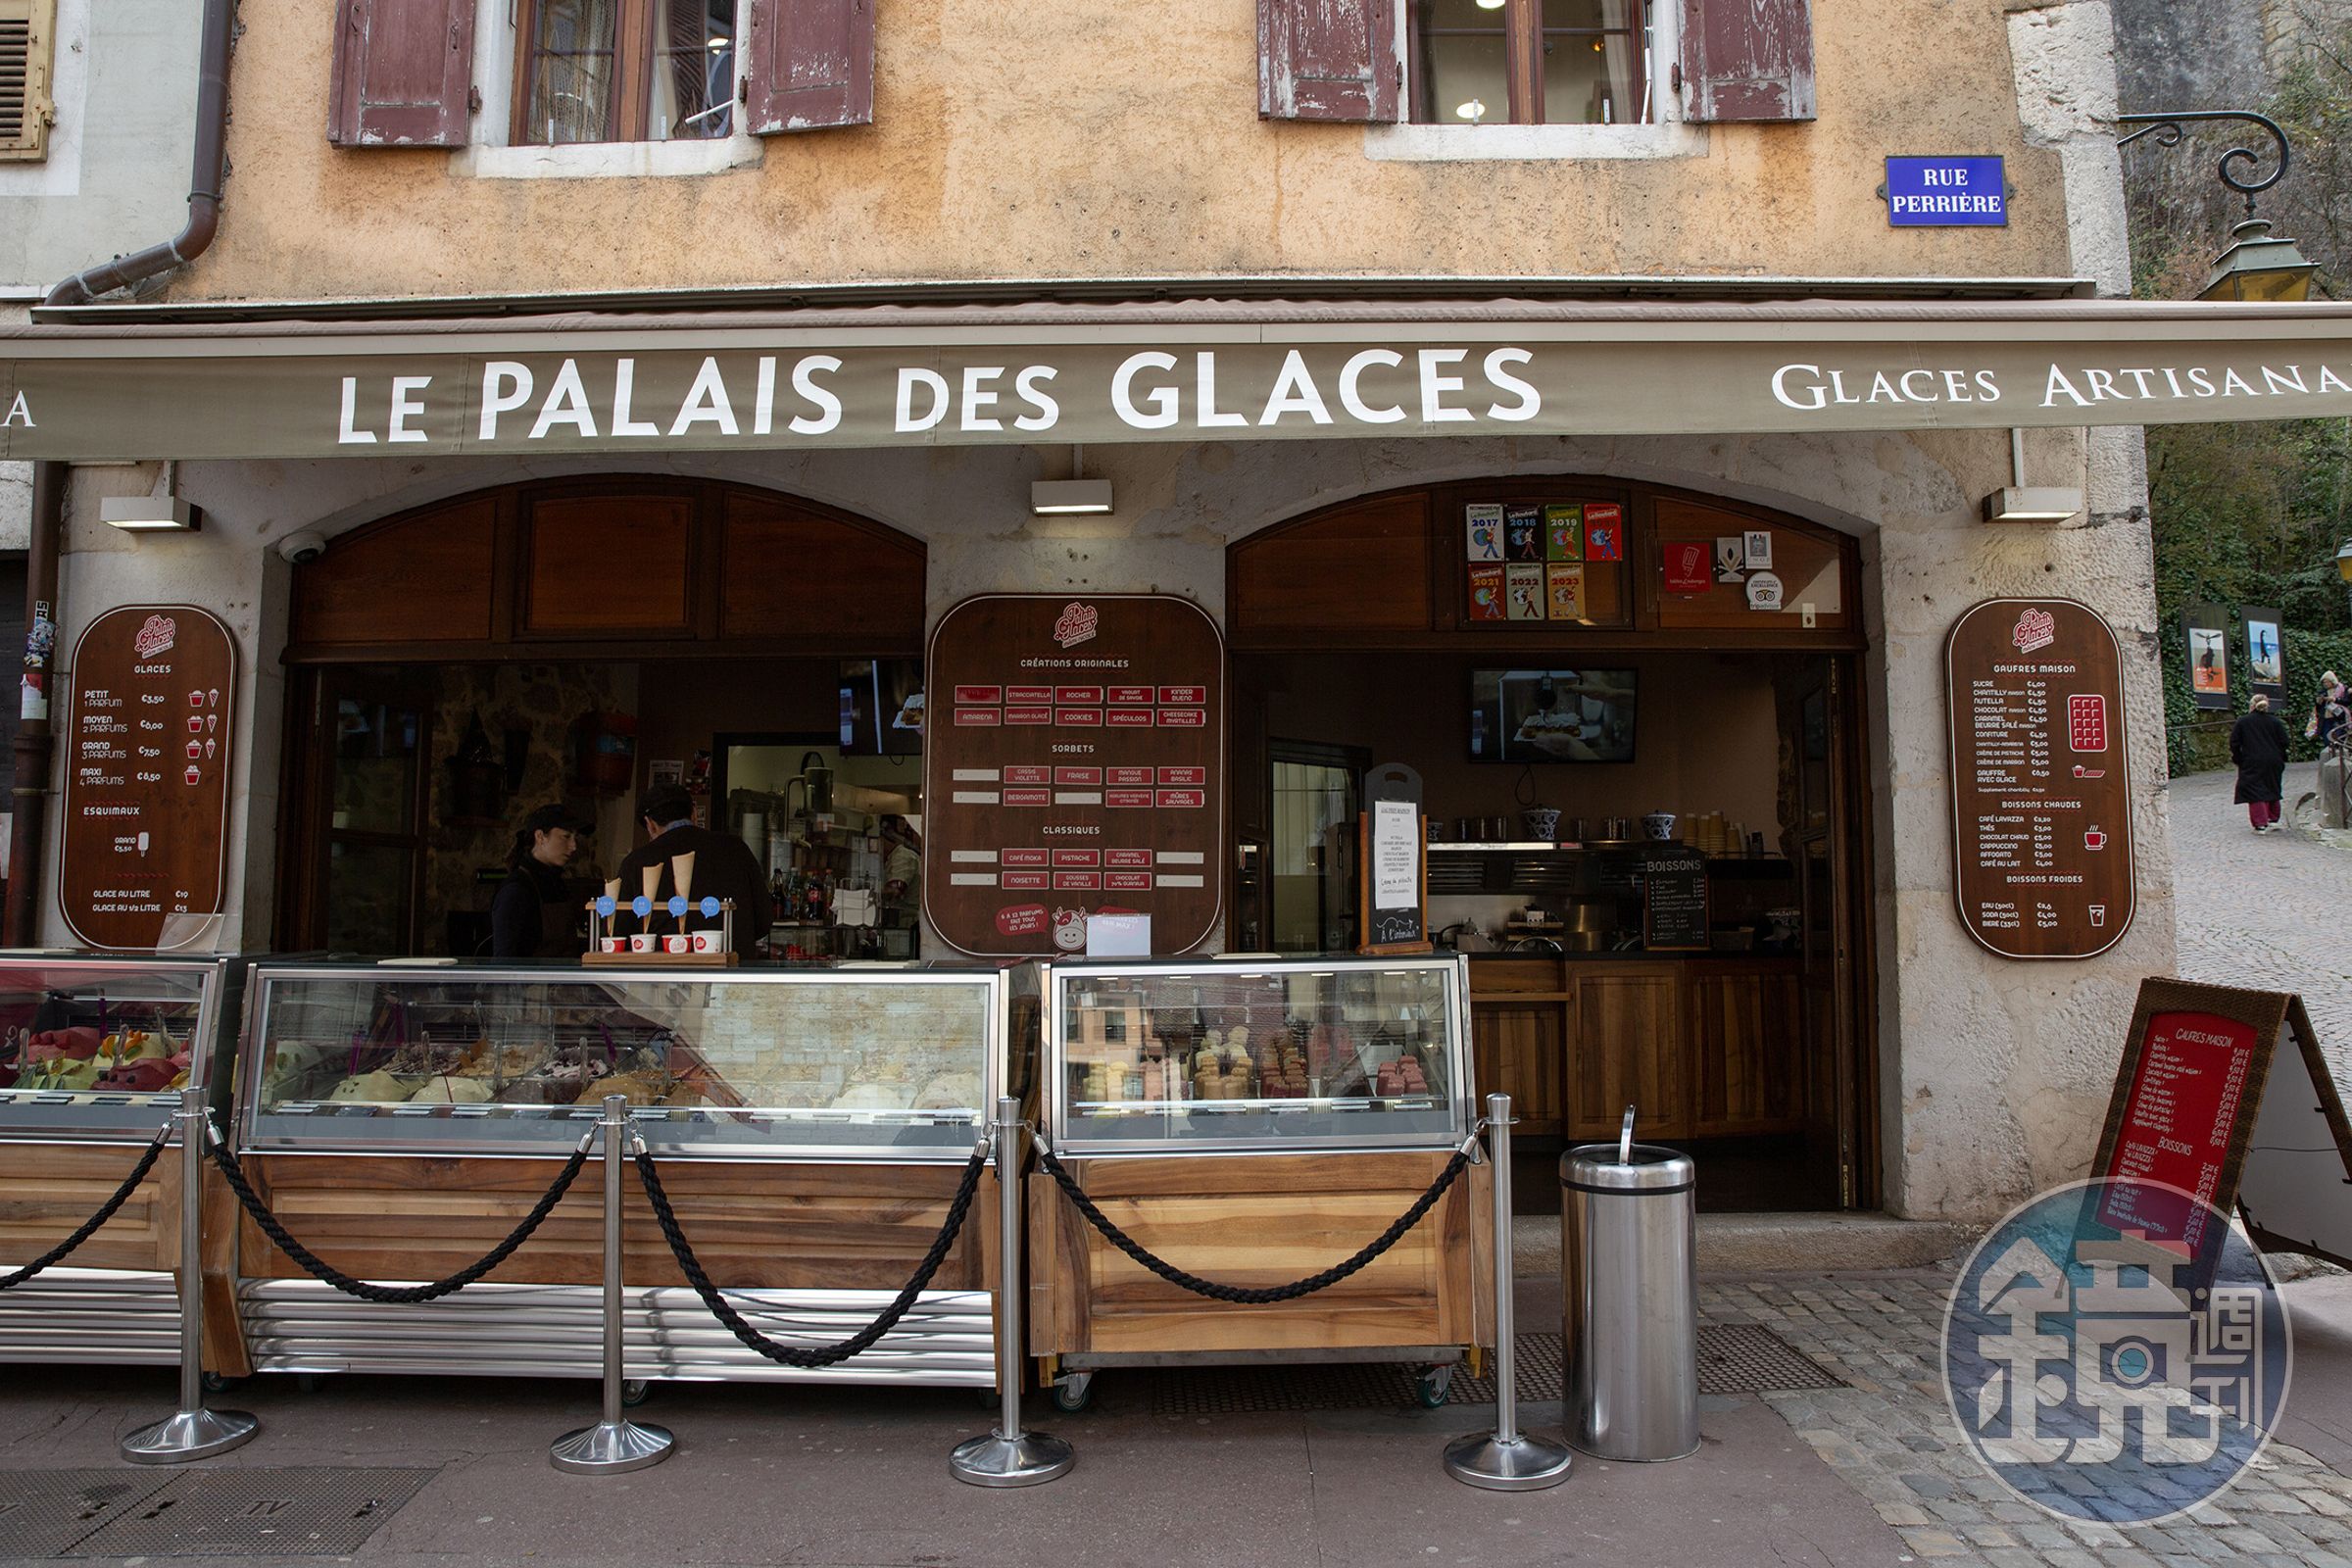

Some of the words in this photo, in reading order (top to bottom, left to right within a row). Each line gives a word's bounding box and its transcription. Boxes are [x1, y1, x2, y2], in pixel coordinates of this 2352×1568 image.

[1924, 169, 1968, 186] RUE
[1892, 192, 2001, 213] PERRIÈRE
[1771, 364, 2001, 411] GLACES
[2037, 363, 2352, 408] ARTISANA
[339, 375, 434, 444] LE
[479, 356, 843, 440] PALAIS
[895, 365, 1060, 433] DES
[1110, 348, 1543, 429] GLACES
[1472, 518, 1498, 527] 2017
[1509, 518, 1537, 527] 2018
[1550, 518, 1578, 527] 2019
[1473, 578, 1499, 587] 2021
[2015, 623, 2050, 646] Glaces
[1020, 657, 1072, 667] CRÉATIONS
[1074, 660, 1129, 668] ORIGINALES
[133, 664, 172, 674] GLACES
[1993, 664, 2036, 673] GAUFRES
[2039, 664, 2076, 673] MAISON
[84, 690, 109, 699] PETIT
[89, 699, 122, 708] PARFUM
[83, 715, 113, 724] MOYEN
[1112, 712, 1147, 721] SPÉCULOOS
[89, 723, 128, 733] PARFUMS
[81, 751, 88, 760] 3
[88, 750, 127, 759] PARFUMS
[79, 767, 102, 776] MAXI
[86, 776, 124, 785] PARFUMS
[83, 807, 141, 816] ESQUIMAUX
[1646, 859, 1701, 872] BOISSONS
[93, 890, 117, 899] GLACE
[118, 890, 129, 899] AU
[129, 890, 151, 899] LITRE
[92, 905, 116, 913] GLACE
[118, 905, 128, 913] AU
[140, 905, 161, 913] LITRE
[2176, 1028, 2207, 1044] GAUFRES
[2205, 1034, 2234, 1048] MAISON
[2157, 1136, 2193, 1156] BOISSONS
